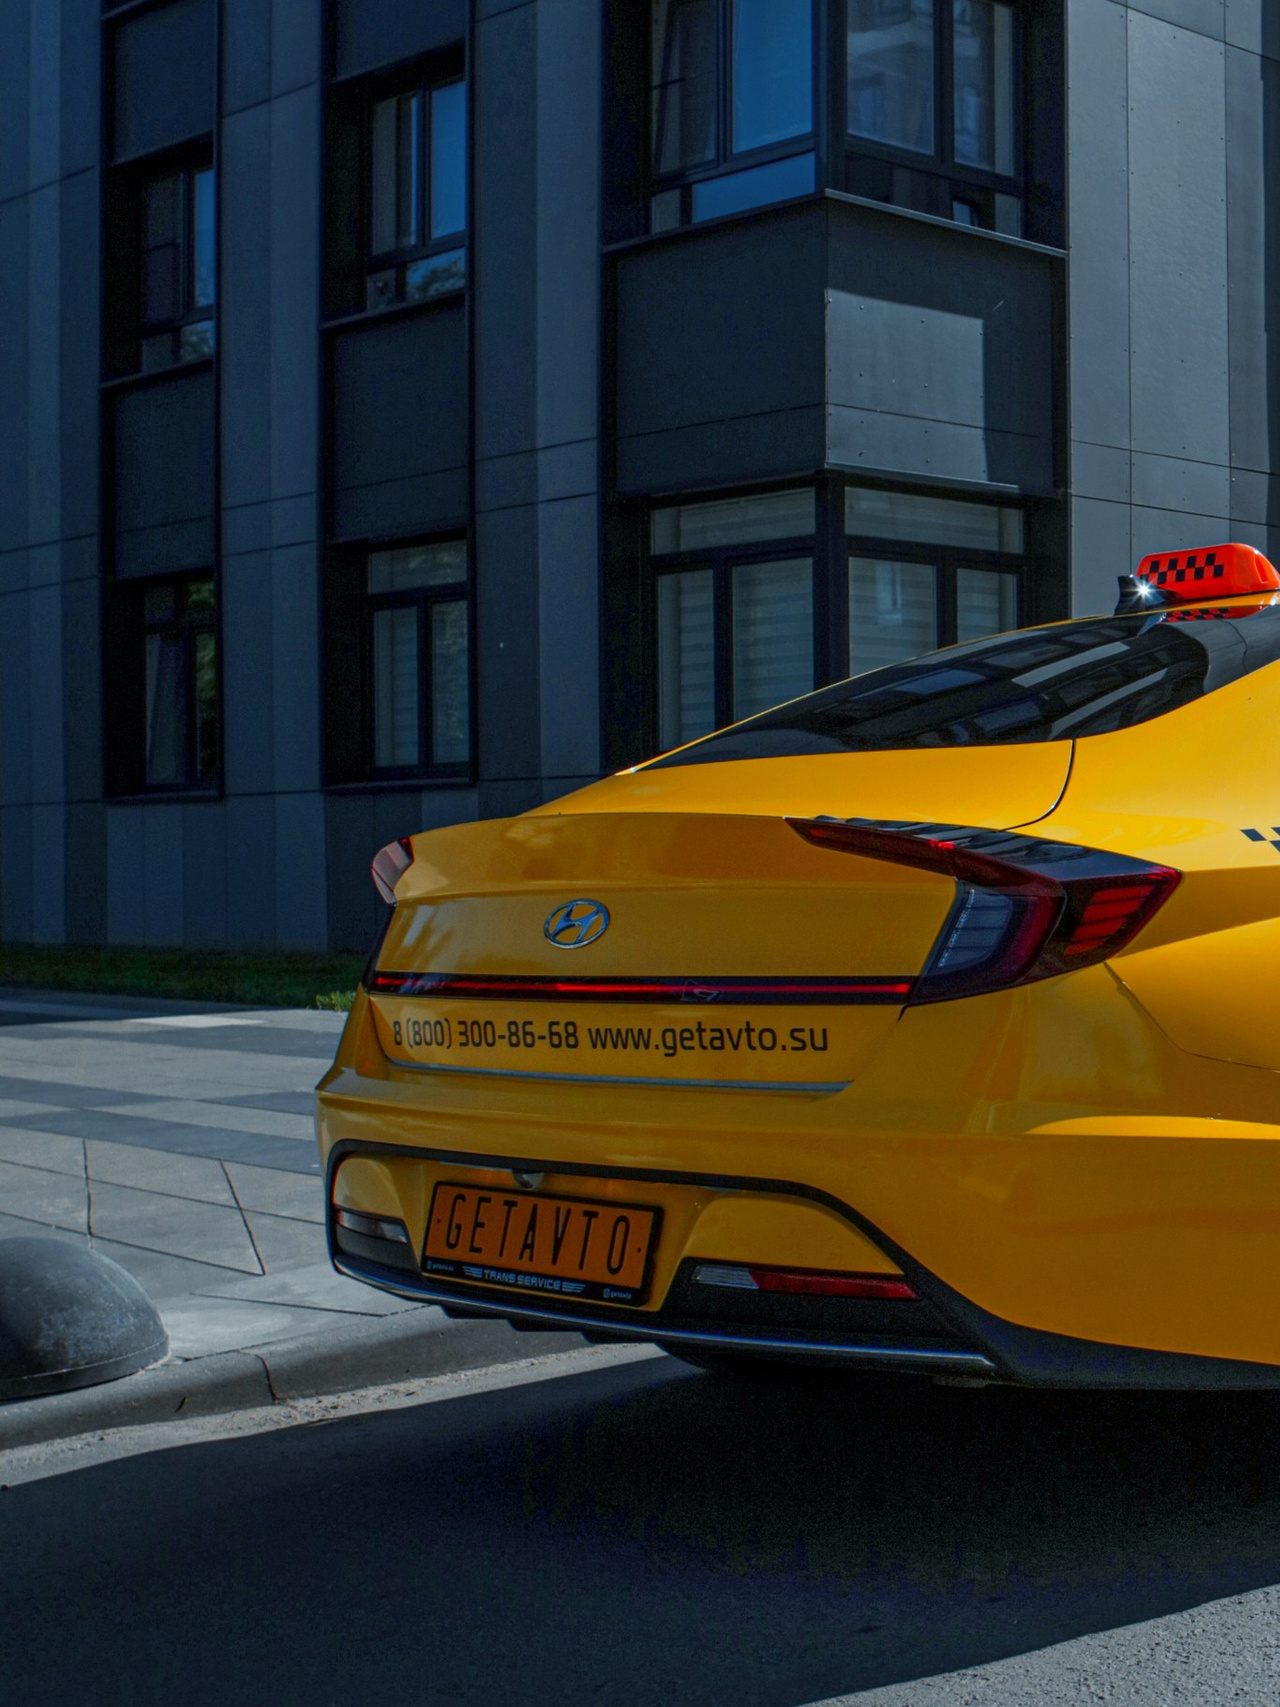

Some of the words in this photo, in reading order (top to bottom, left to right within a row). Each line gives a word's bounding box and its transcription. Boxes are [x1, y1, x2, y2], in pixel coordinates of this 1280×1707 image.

[392, 1021, 402, 1046] 8
[406, 1018, 451, 1050] (800)
[458, 1020, 578, 1049] 300-86-68
[588, 1021, 828, 1057] www.getavto.su
[446, 1193, 630, 1275] GETAVTO
[484, 1269, 516, 1284] TRANS
[517, 1274, 561, 1291] SERVICE
